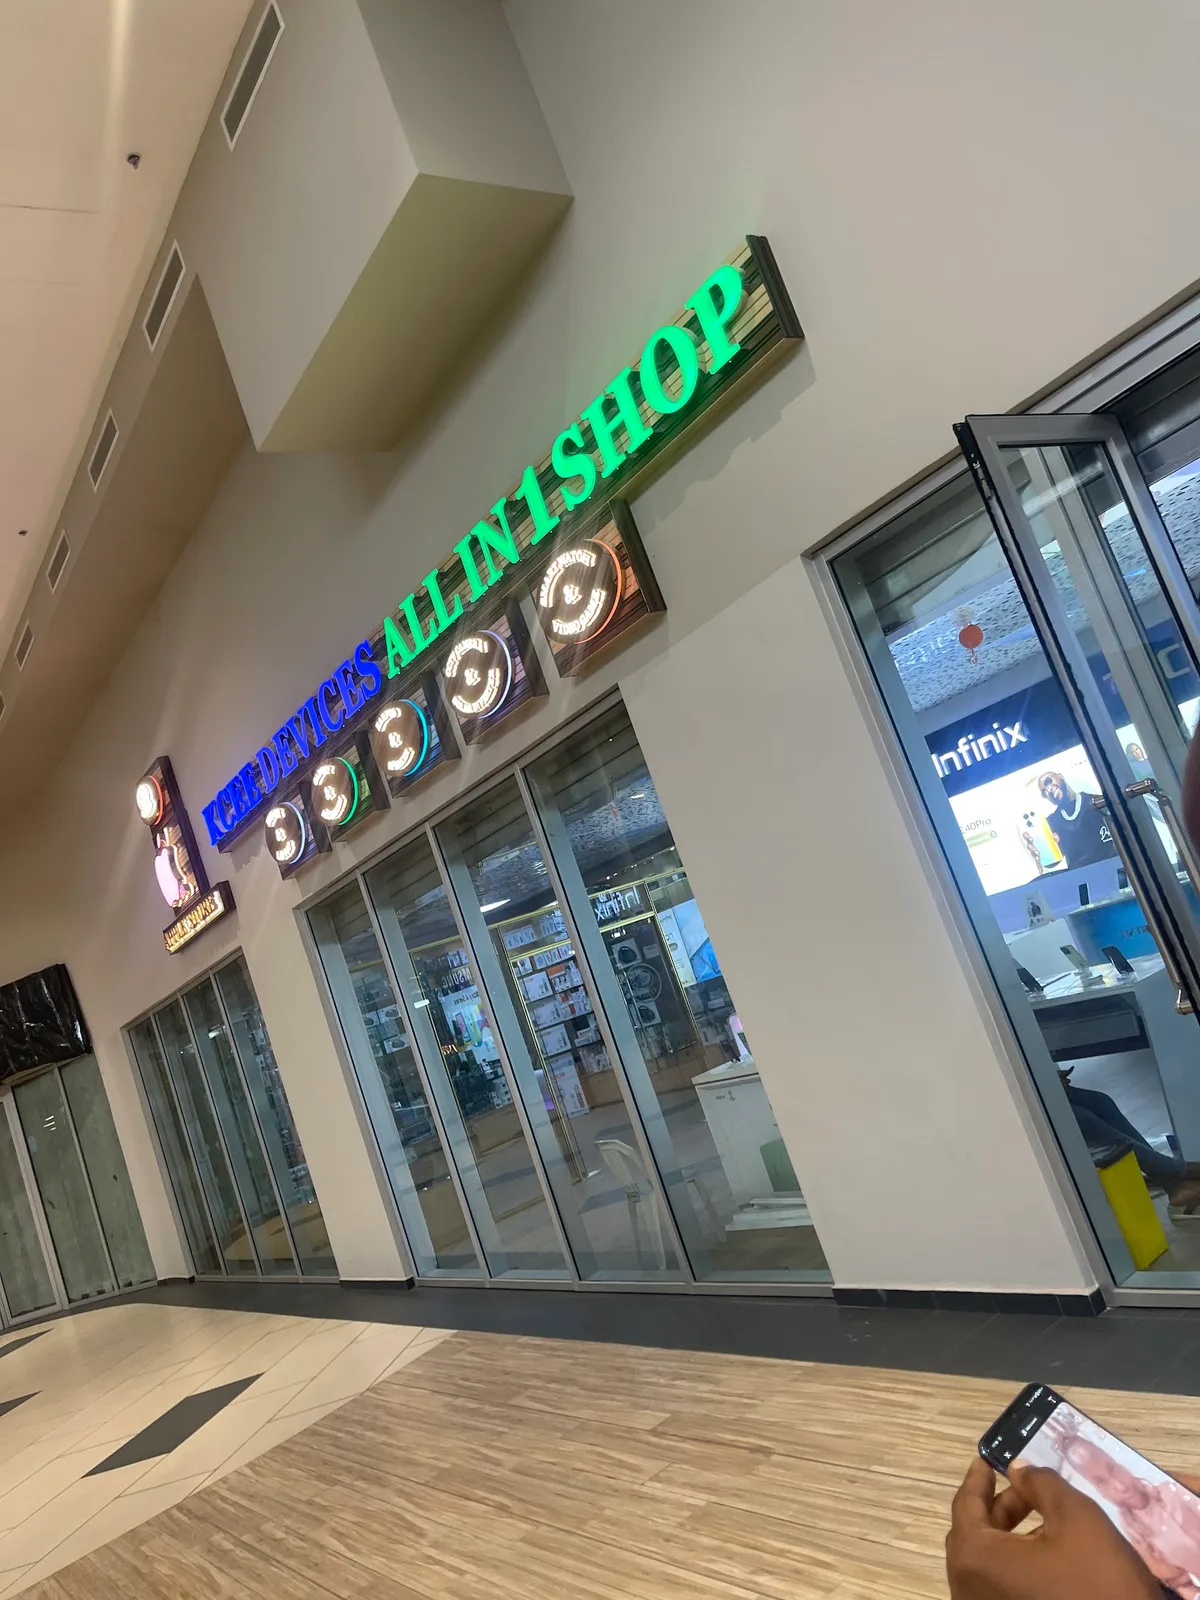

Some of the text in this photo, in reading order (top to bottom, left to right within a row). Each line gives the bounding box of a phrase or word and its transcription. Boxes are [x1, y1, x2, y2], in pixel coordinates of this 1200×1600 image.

[201, 265, 744, 846] KCEE DEVICES ALL IN 1 SHOP
[556, 549, 596, 569] WATCH
[931, 721, 1028, 778] Infinix
